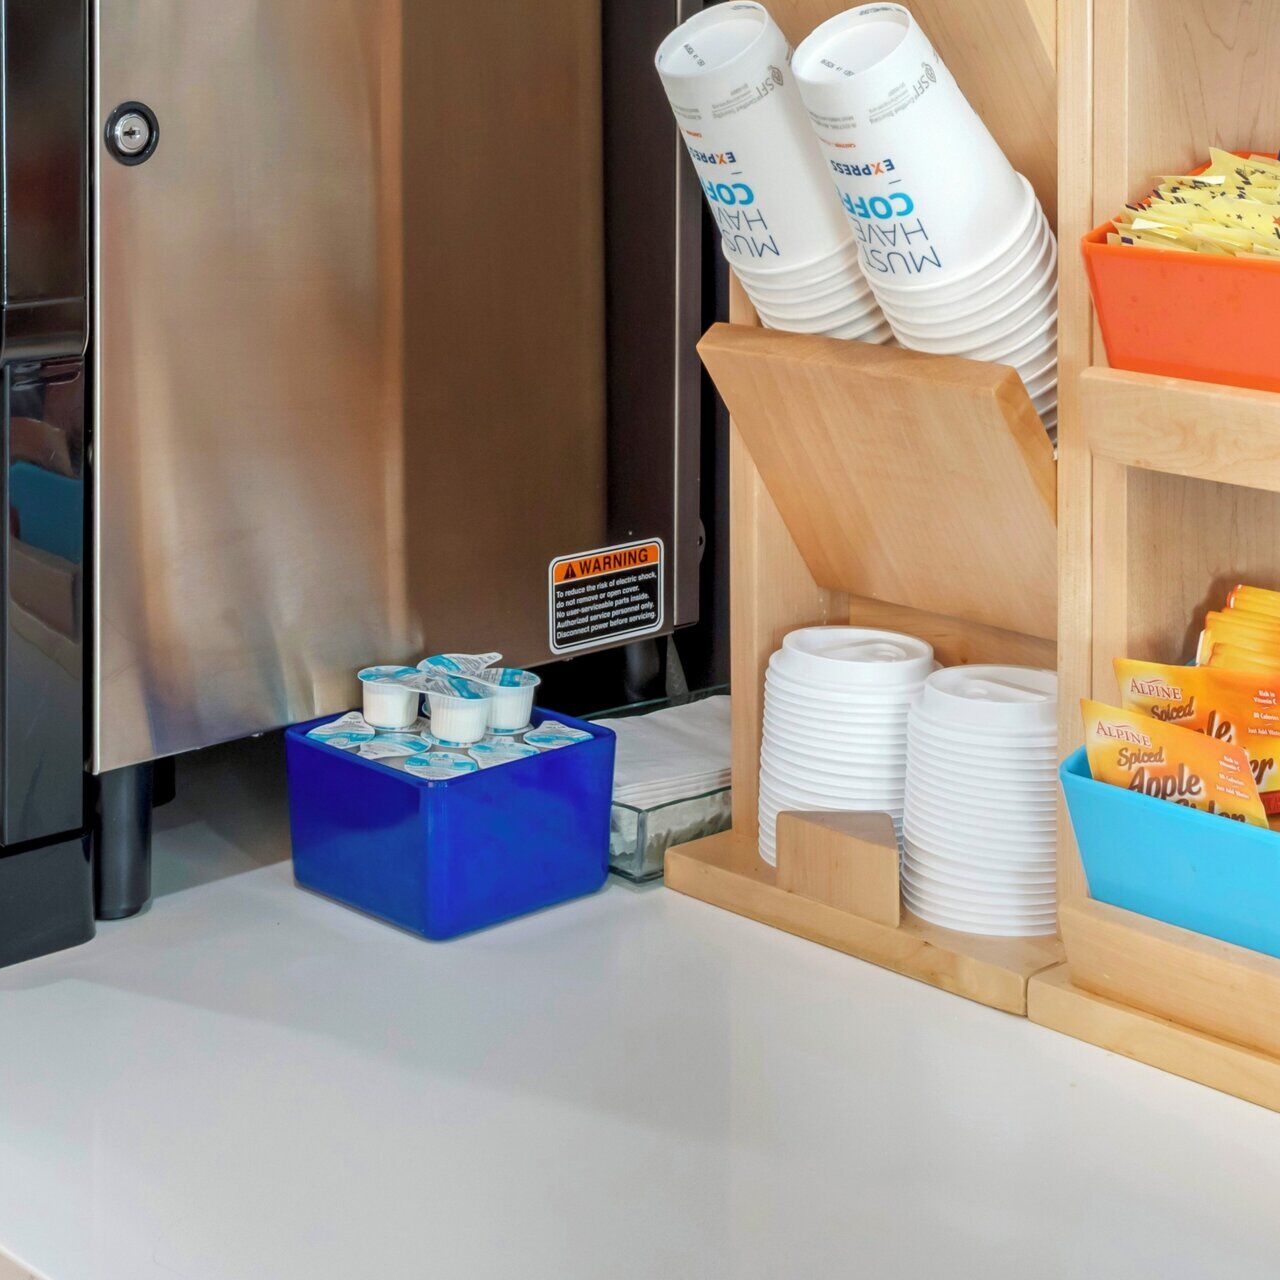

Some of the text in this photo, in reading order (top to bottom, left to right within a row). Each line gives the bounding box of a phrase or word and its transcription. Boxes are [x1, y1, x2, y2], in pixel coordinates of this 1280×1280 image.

[912, 75, 929, 98] SFI
[831, 159, 895, 176] EXPRESS
[852, 218, 929, 246] HAVE
[862, 245, 942, 274] MUST
[579, 548, 648, 575] WARNING
[556, 590, 564, 598] To
[564, 587, 585, 597] reduce
[586, 584, 596, 592] the
[596, 581, 608, 590] risk
[608, 579, 615, 587] of
[615, 574, 637, 585] electric
[565, 598, 576, 607] not
[576, 593, 598, 604] remove
[606, 589, 621, 599] open
[622, 585, 640, 594] cover.
[556, 592, 649, 619] No user-serviceable parts inside.
[557, 615, 589, 629] Authorized
[590, 610, 611, 621] service
[611, 603, 639, 618] personnel
[557, 611, 656, 639] Disconnect power before servicing.
[1130, 678, 1182, 700] ALPINE
[1150, 696, 1195, 721] Spiced
[1096, 721, 1151, 747] ALPINE
[1117, 747, 1164, 769] Spiced
[1129, 763, 1202, 799] Apple
